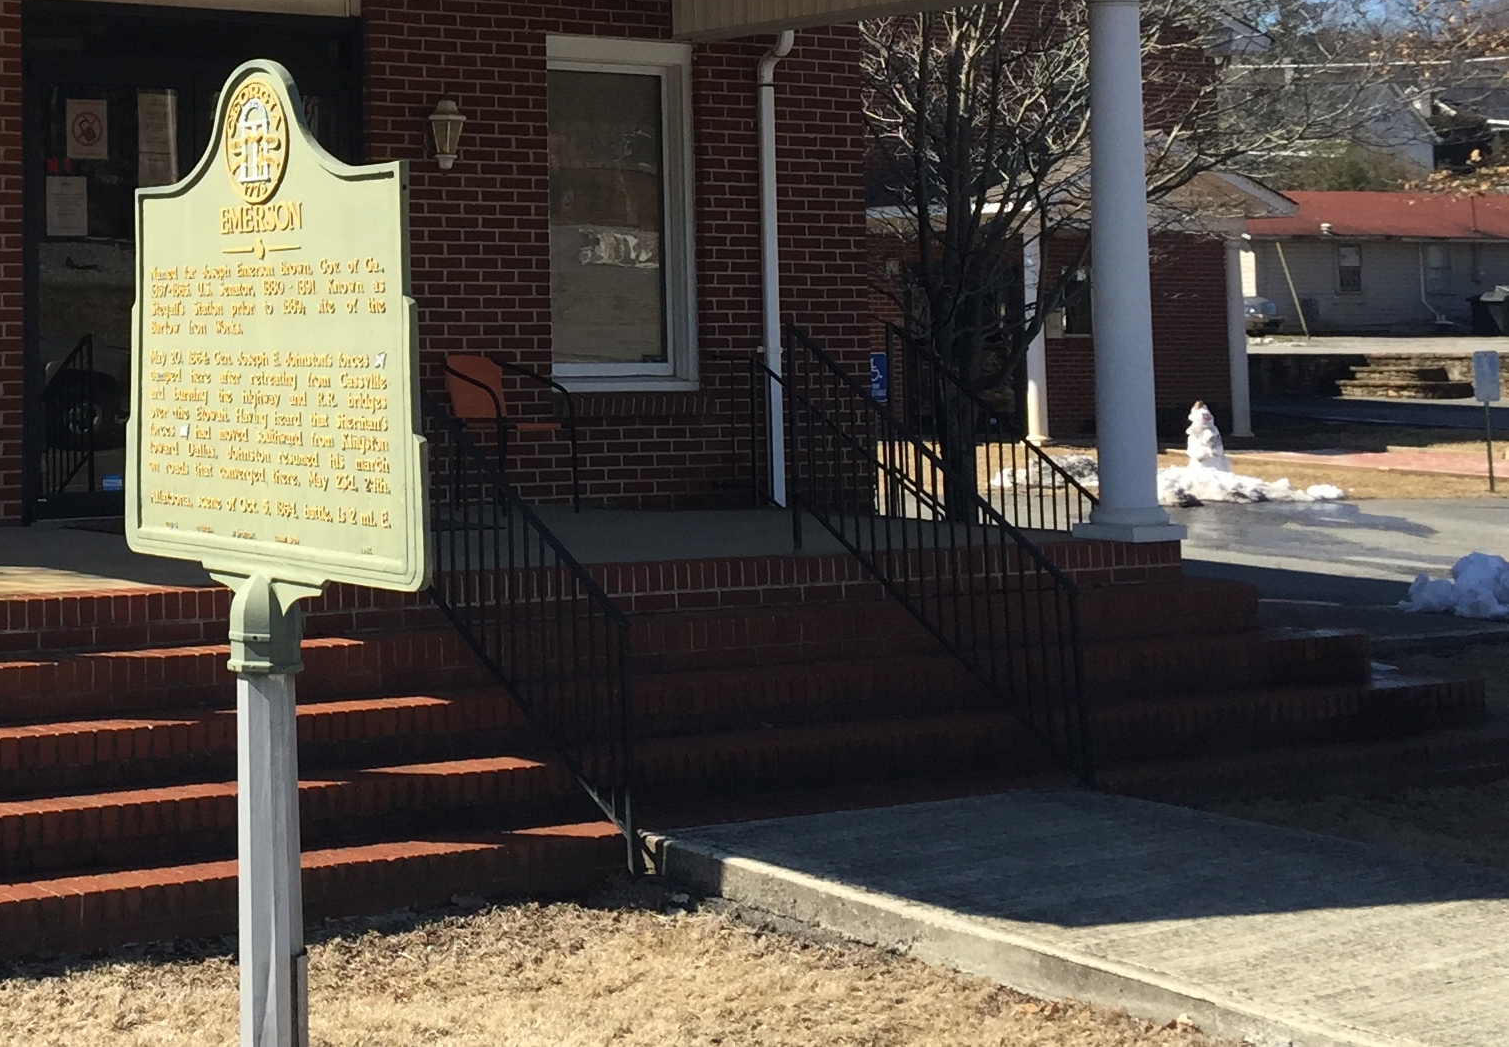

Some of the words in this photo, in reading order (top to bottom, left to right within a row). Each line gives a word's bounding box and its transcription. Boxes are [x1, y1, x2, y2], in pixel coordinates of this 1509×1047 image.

[227, 85, 282, 139] GEORGIA
[219, 202, 302, 235] EMERSON
[237, 262, 275, 277] Emerson
[348, 258, 359, 273] of
[327, 278, 364, 294] Known
[372, 280, 386, 293] as
[194, 301, 223, 315] Station
[232, 301, 255, 317] prior
[264, 301, 274, 315] to
[346, 298, 358, 314] of
[367, 297, 386, 314] the
[188, 319, 207, 334] Iron
[150, 350, 167, 366] May
[237, 351, 269, 368] Joseph
[338, 351, 370, 368] forces
[191, 369, 211, 384] here
[219, 370, 241, 384] after
[251, 371, 297, 391] retreating
[307, 372, 331, 387] from
[340, 372, 387, 389] Cassville
[174, 386, 208, 405] burning
[217, 388, 233, 403] the
[243, 389, 280, 408] highway
[289, 391, 307, 406] and
[348, 392, 387, 414] bridges
[150, 407, 168, 419] over
[236, 408, 268, 429] Having
[274, 411, 302, 426] heard
[309, 412, 329, 427] that
[150, 423, 175, 437] forces
[195, 425, 211, 439] had
[219, 428, 249, 442] moved
[257, 429, 303, 446] southward
[311, 433, 334, 447] from
[341, 433, 389, 454] Kingston
[149, 441, 179, 455] toward
[227, 445, 271, 463] Johnston
[278, 452, 319, 467] resumed
[329, 453, 345, 469] his
[355, 457, 390, 473] march
[149, 461, 159, 472] on
[166, 461, 189, 475] roads
[194, 462, 213, 477] that
[219, 465, 266, 485] converged
[308, 470, 329, 491] May
[197, 495, 222, 510] scene
[226, 496, 236, 511] of
[238, 496, 259, 513] Oct.
[337, 506, 346, 523] is
[349, 506, 357, 525] 2
[360, 510, 377, 527] mi.
[381, 510, 391, 529] E.
